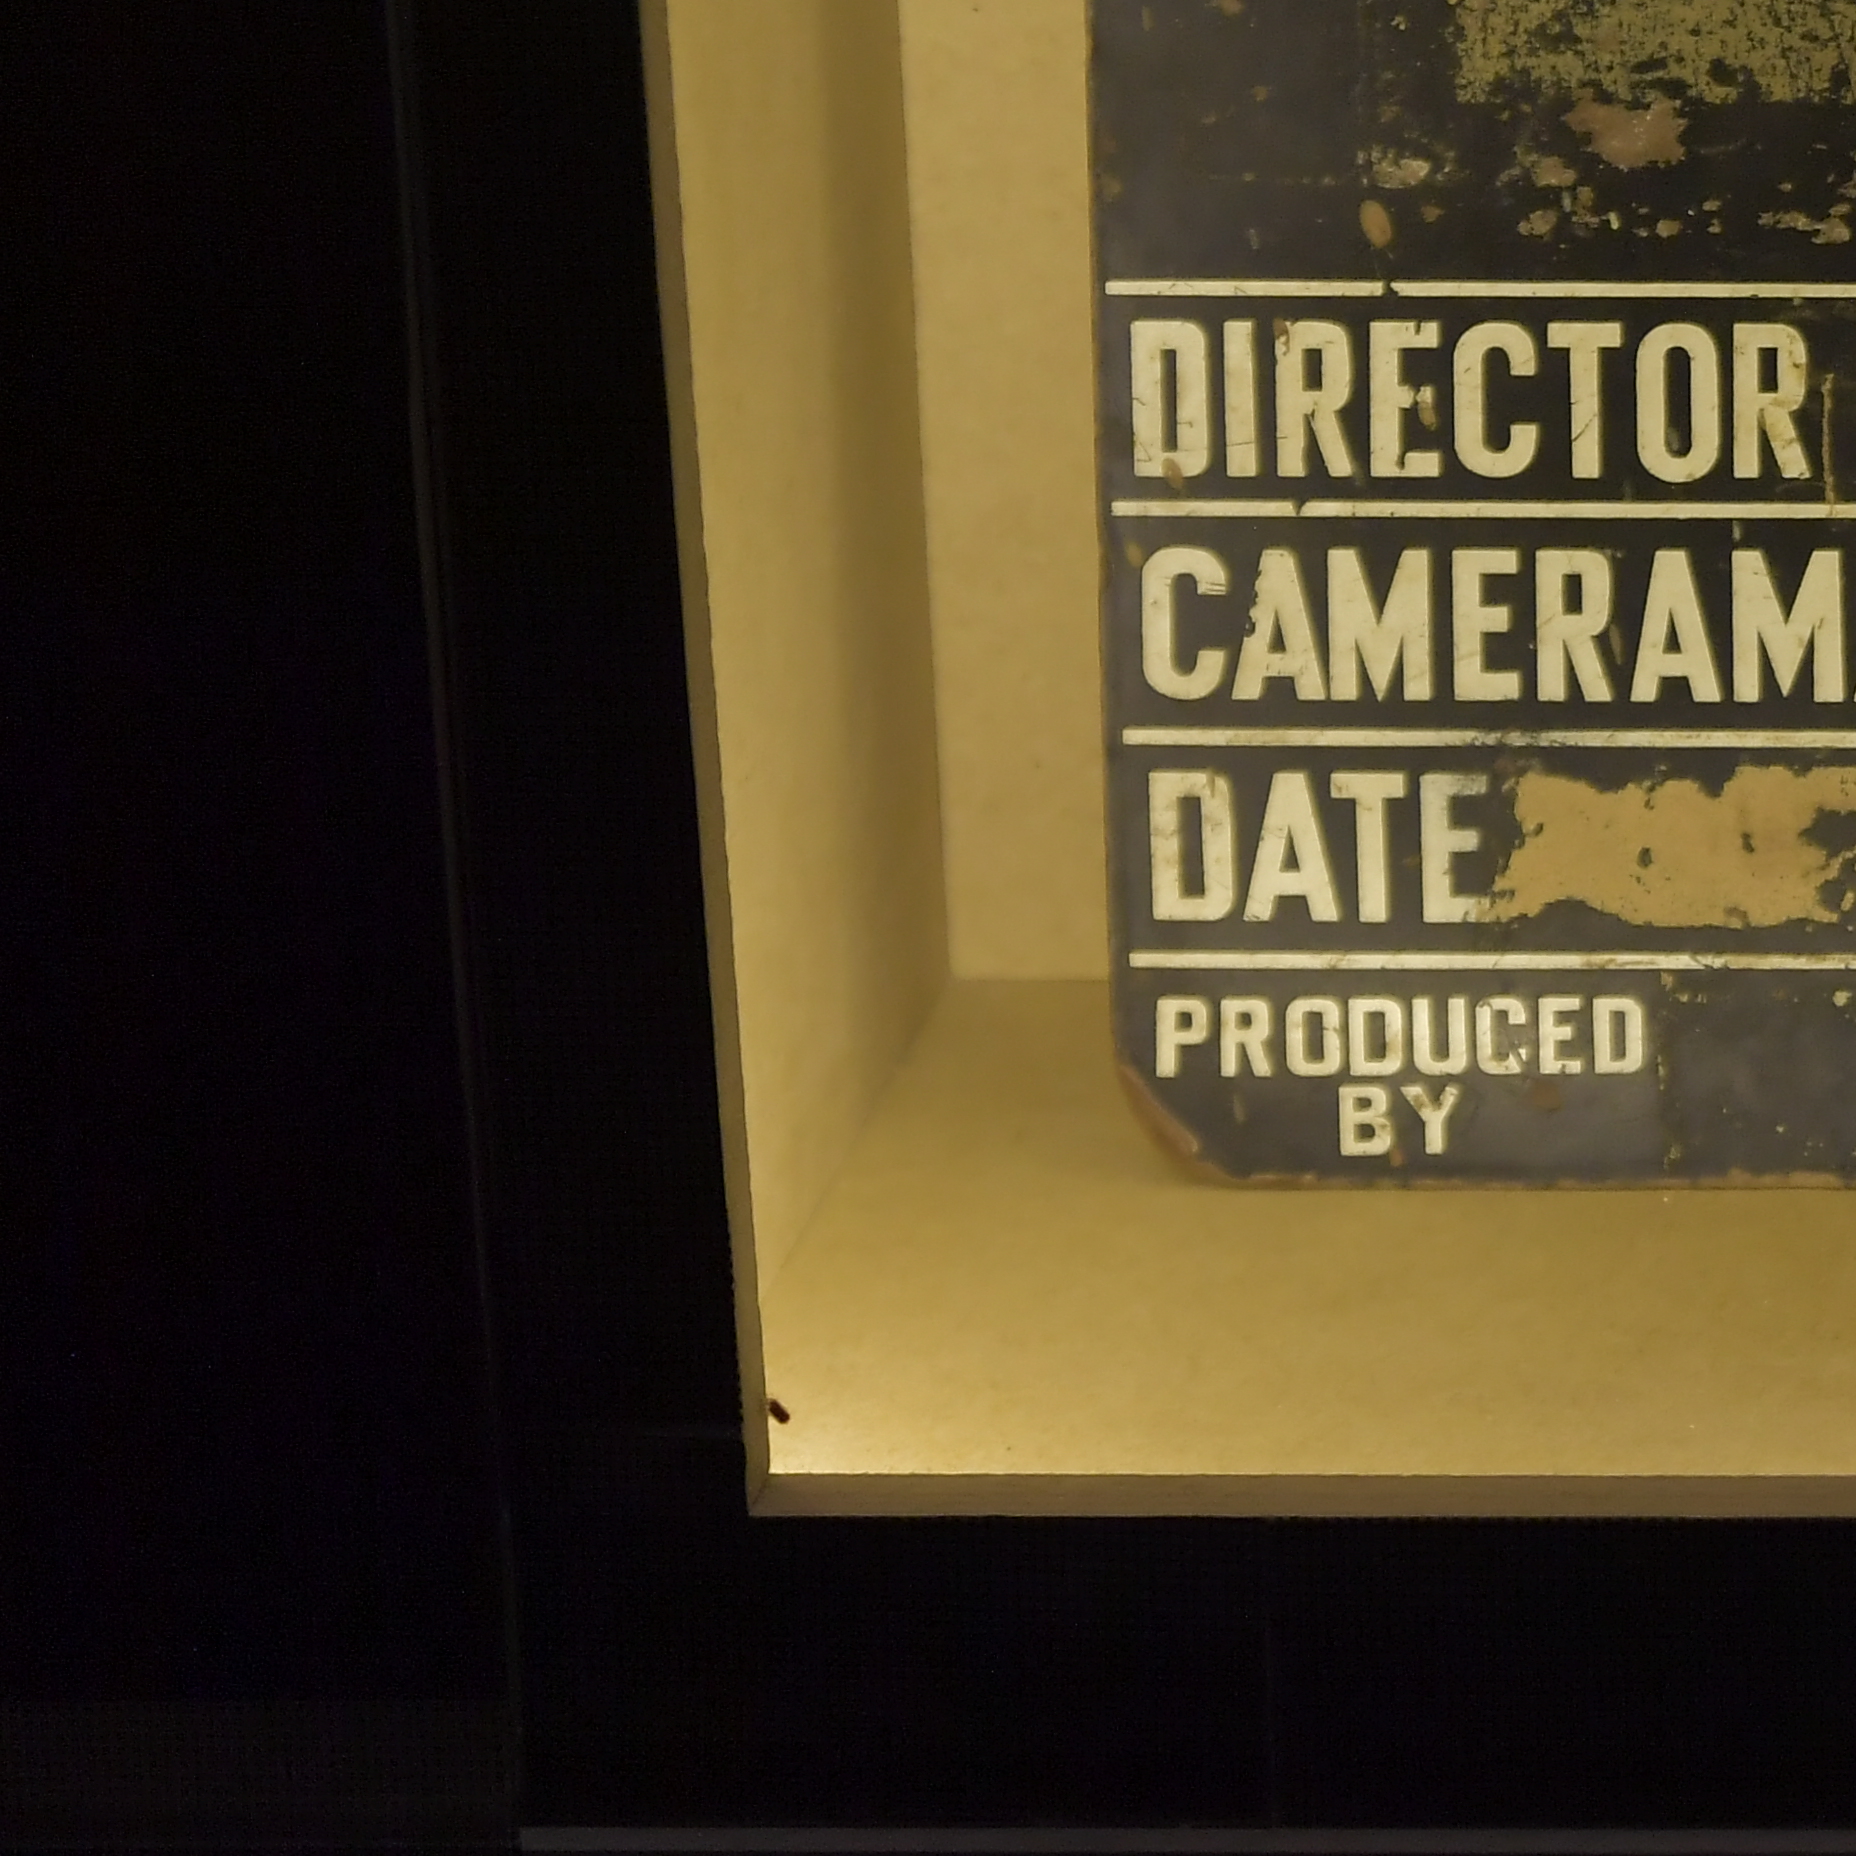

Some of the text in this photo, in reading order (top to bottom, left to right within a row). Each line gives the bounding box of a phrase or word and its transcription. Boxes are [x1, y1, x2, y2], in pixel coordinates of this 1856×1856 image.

[1128, 318, 1810, 482] DIRECTOR
[1148, 769, 1490, 924] DATE
[1154, 996, 1647, 1080] PRODUCED
[1337, 1084, 1462, 1158] BY
